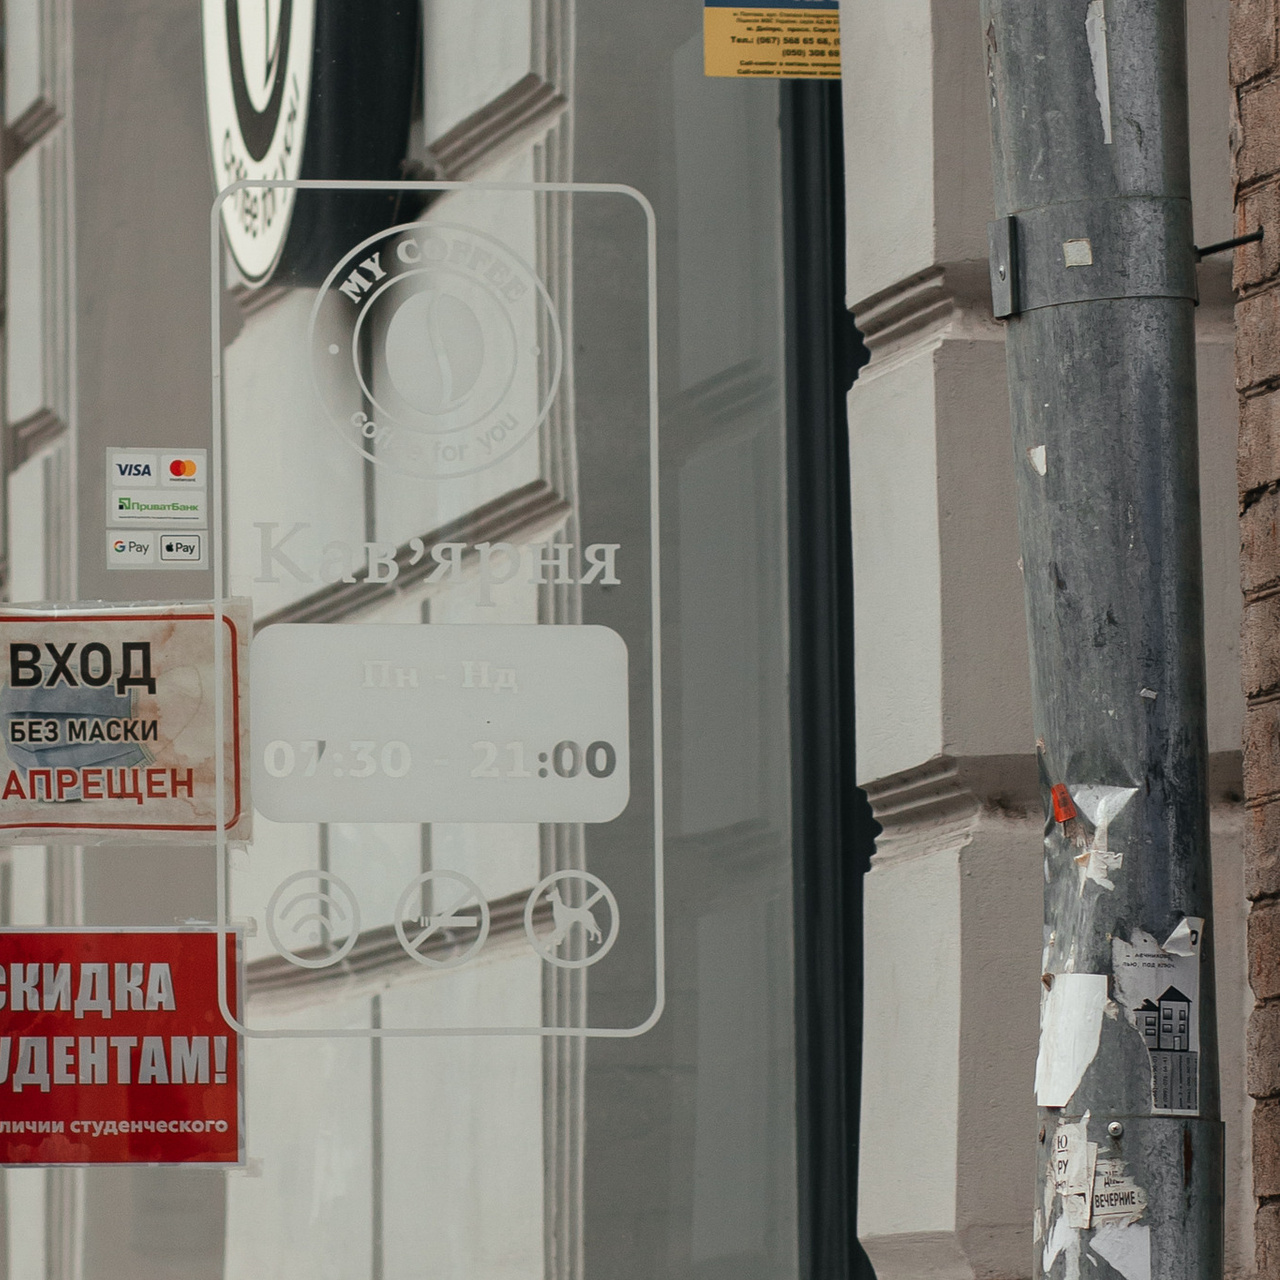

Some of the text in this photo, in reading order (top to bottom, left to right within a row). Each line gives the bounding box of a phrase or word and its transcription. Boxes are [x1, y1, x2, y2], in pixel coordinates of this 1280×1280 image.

[339, 237, 528, 304] MY COFFEE
[476, 413, 520, 455] you
[116, 463, 152, 476] VISA
[131, 502, 199, 511] ПриватБанк
[128, 541, 149, 555] Pay
[176, 542, 195, 555] Pay
[9, 641, 157, 695] ВХОД
[361, 659, 419, 688] Пн
[461, 660, 519, 694] Нд
[10, 718, 159, 744] БЕЗ МАСКИ
[263, 739, 412, 779] 07:30
[469, 739, 617, 779] 21:00
[70, 1119, 229, 1137] студенческого
[1094, 1191, 1136, 1208] ВЕЧЕРНИЕ
